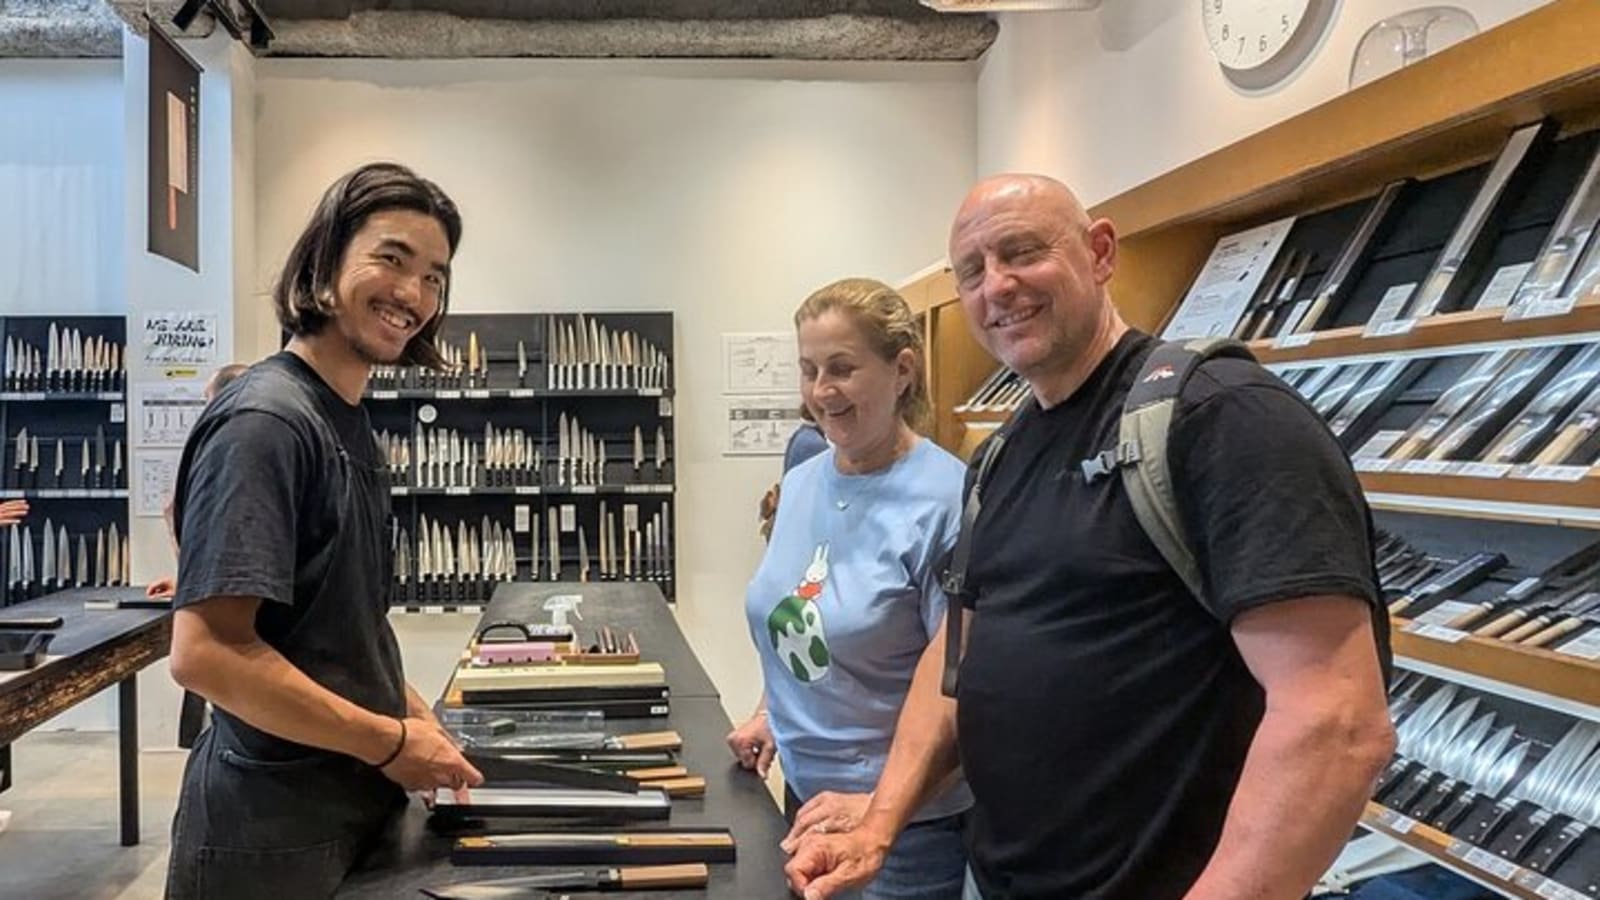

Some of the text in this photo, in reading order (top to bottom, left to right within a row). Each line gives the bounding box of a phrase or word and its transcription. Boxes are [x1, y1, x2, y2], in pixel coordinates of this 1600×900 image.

[1222, 24, 1229, 41] 8
[1281, 15, 1289, 33] 5
[1239, 37, 1245, 55] 7
[1259, 34, 1267, 52] 6
